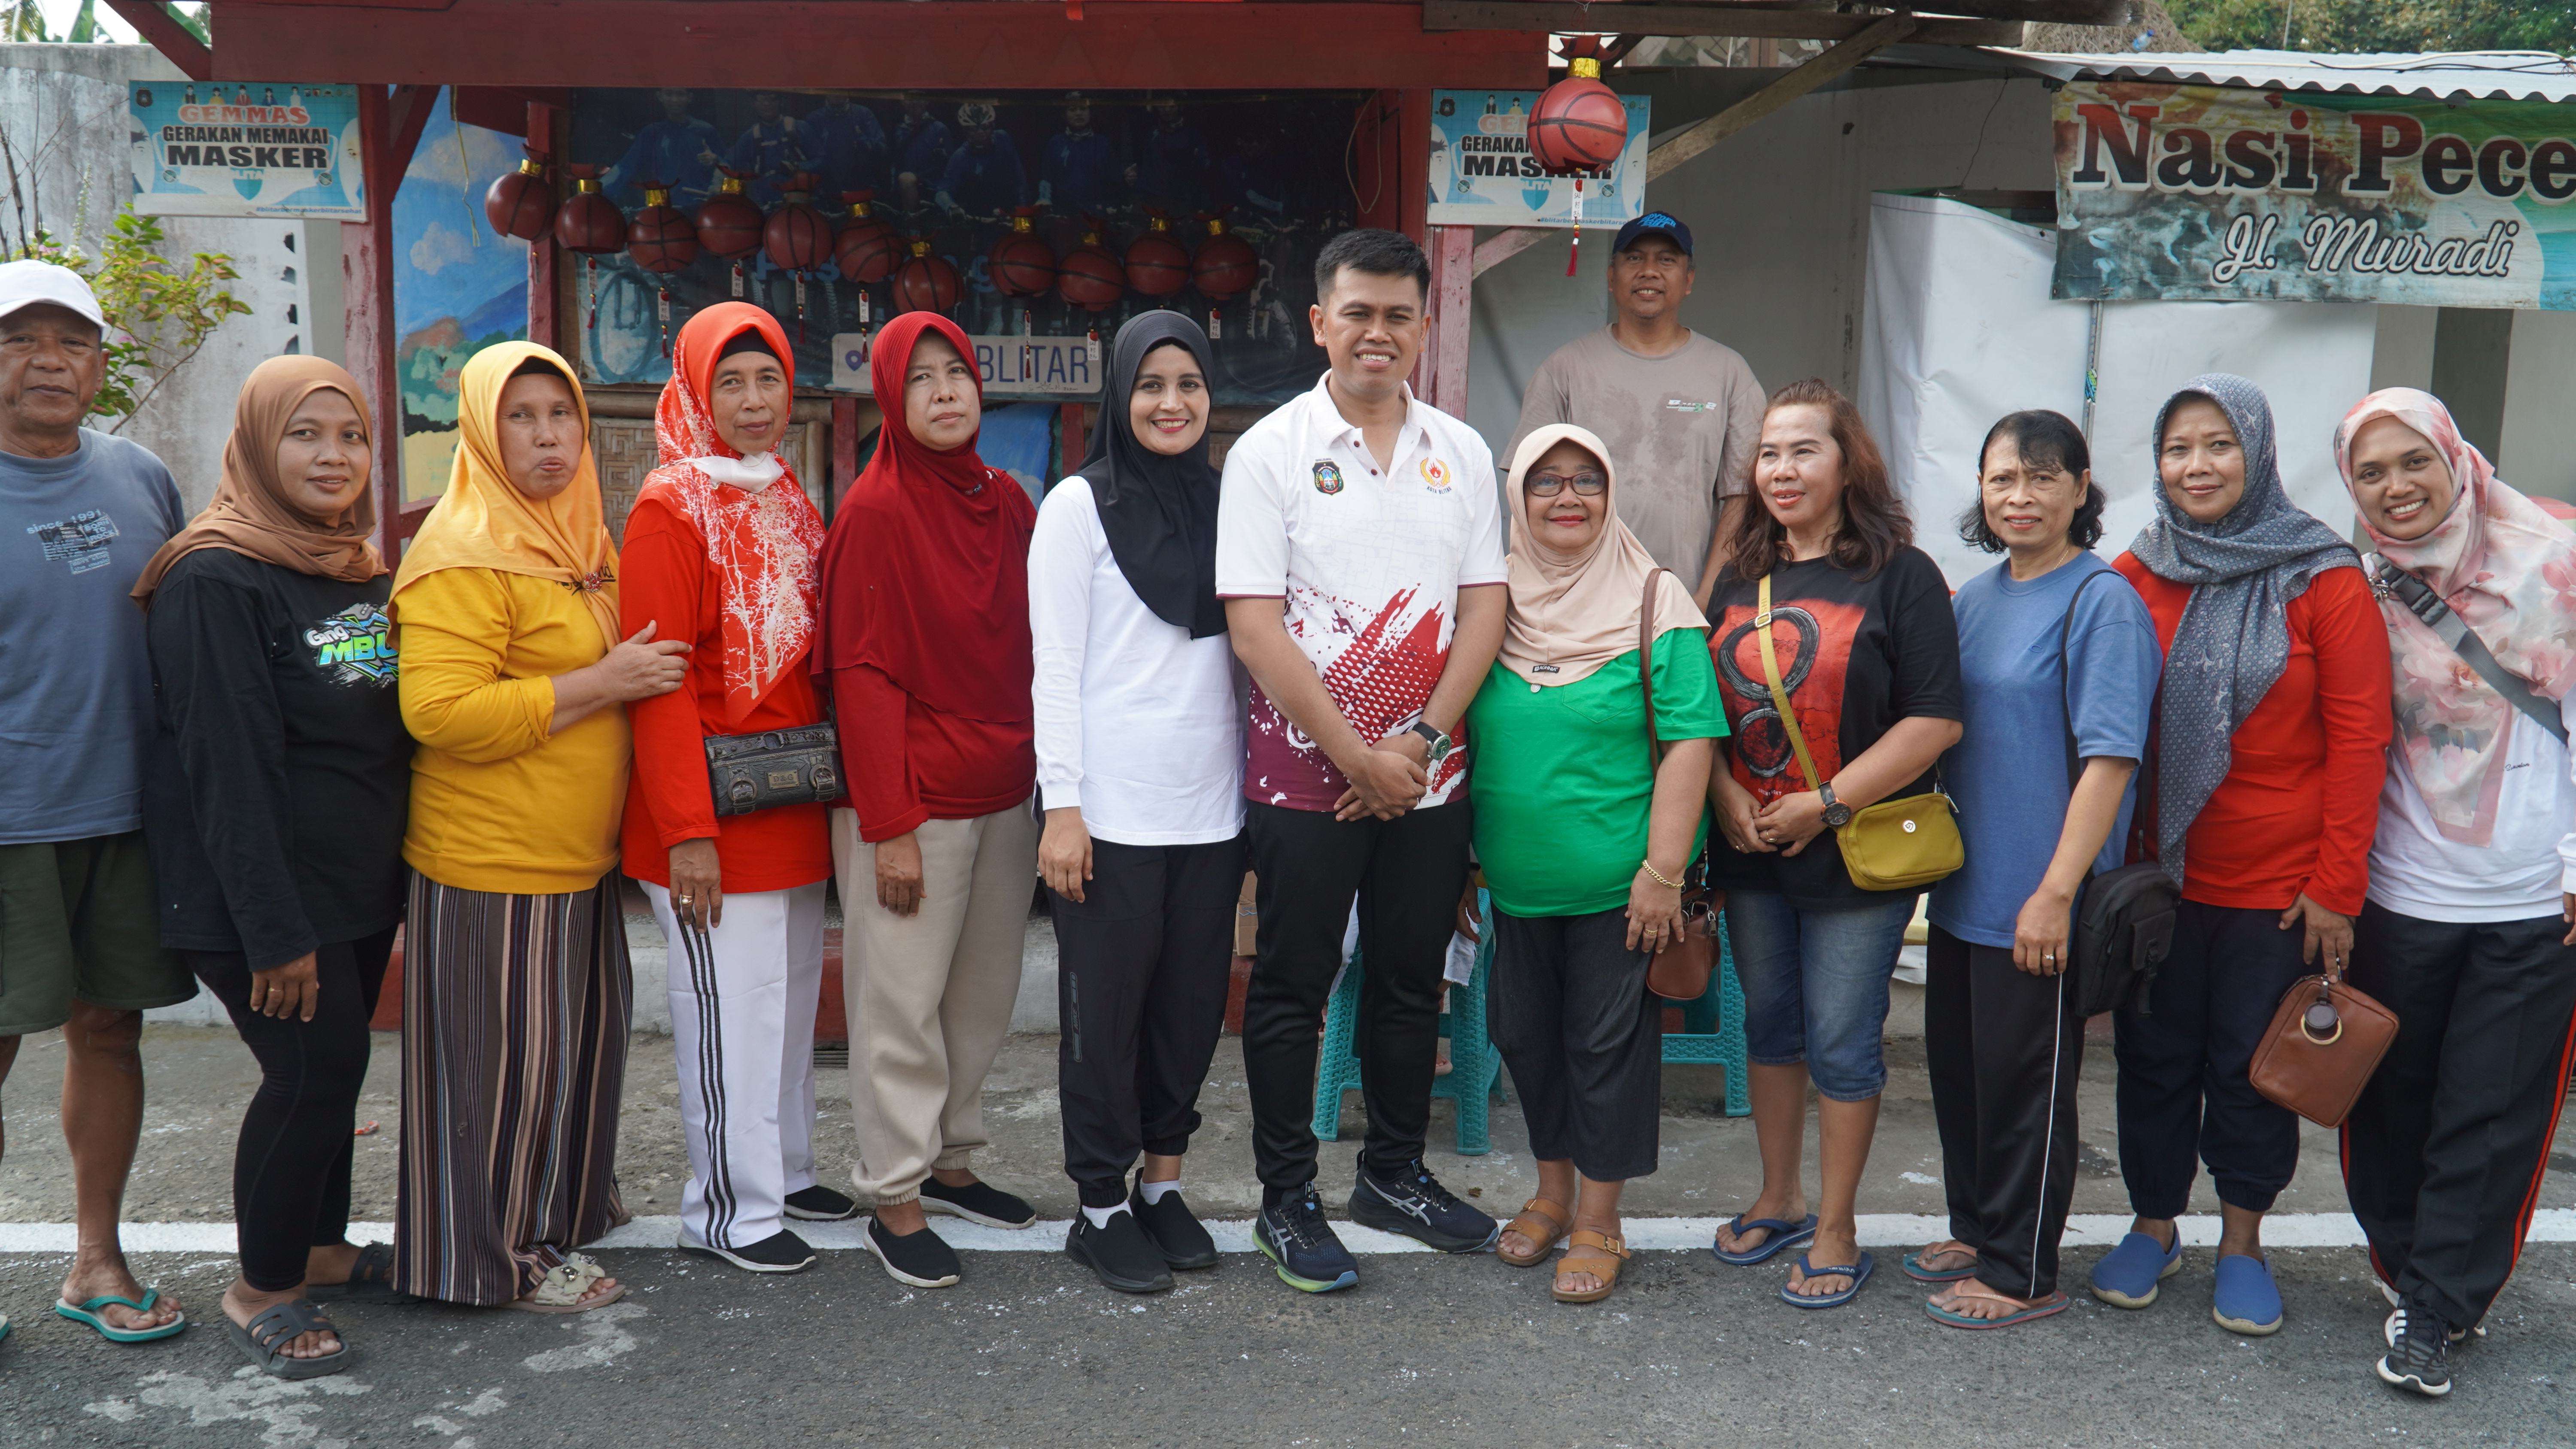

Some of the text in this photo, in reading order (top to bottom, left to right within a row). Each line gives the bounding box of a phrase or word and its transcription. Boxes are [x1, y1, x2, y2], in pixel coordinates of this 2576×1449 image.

[179, 105, 310, 125] GEMMAS
[163, 126, 328, 144] GERAKAN MEMAKAI
[168, 145, 327, 168] MASKER
[2072, 103, 2314, 190] Nasi
[1464, 155, 1611, 179] MAS
[2303, 214, 2520, 278] Muradi
[976, 345, 1089, 383] BLITAR
[1427, 485, 1452, 494] KOTA BLITAR
[27, 520, 64, 534] since
[85, 519, 110, 531] BORN
[90, 529, 114, 541] ROCK
[306, 625, 350, 646] Gang
[773, 773, 794, 782] D&G
